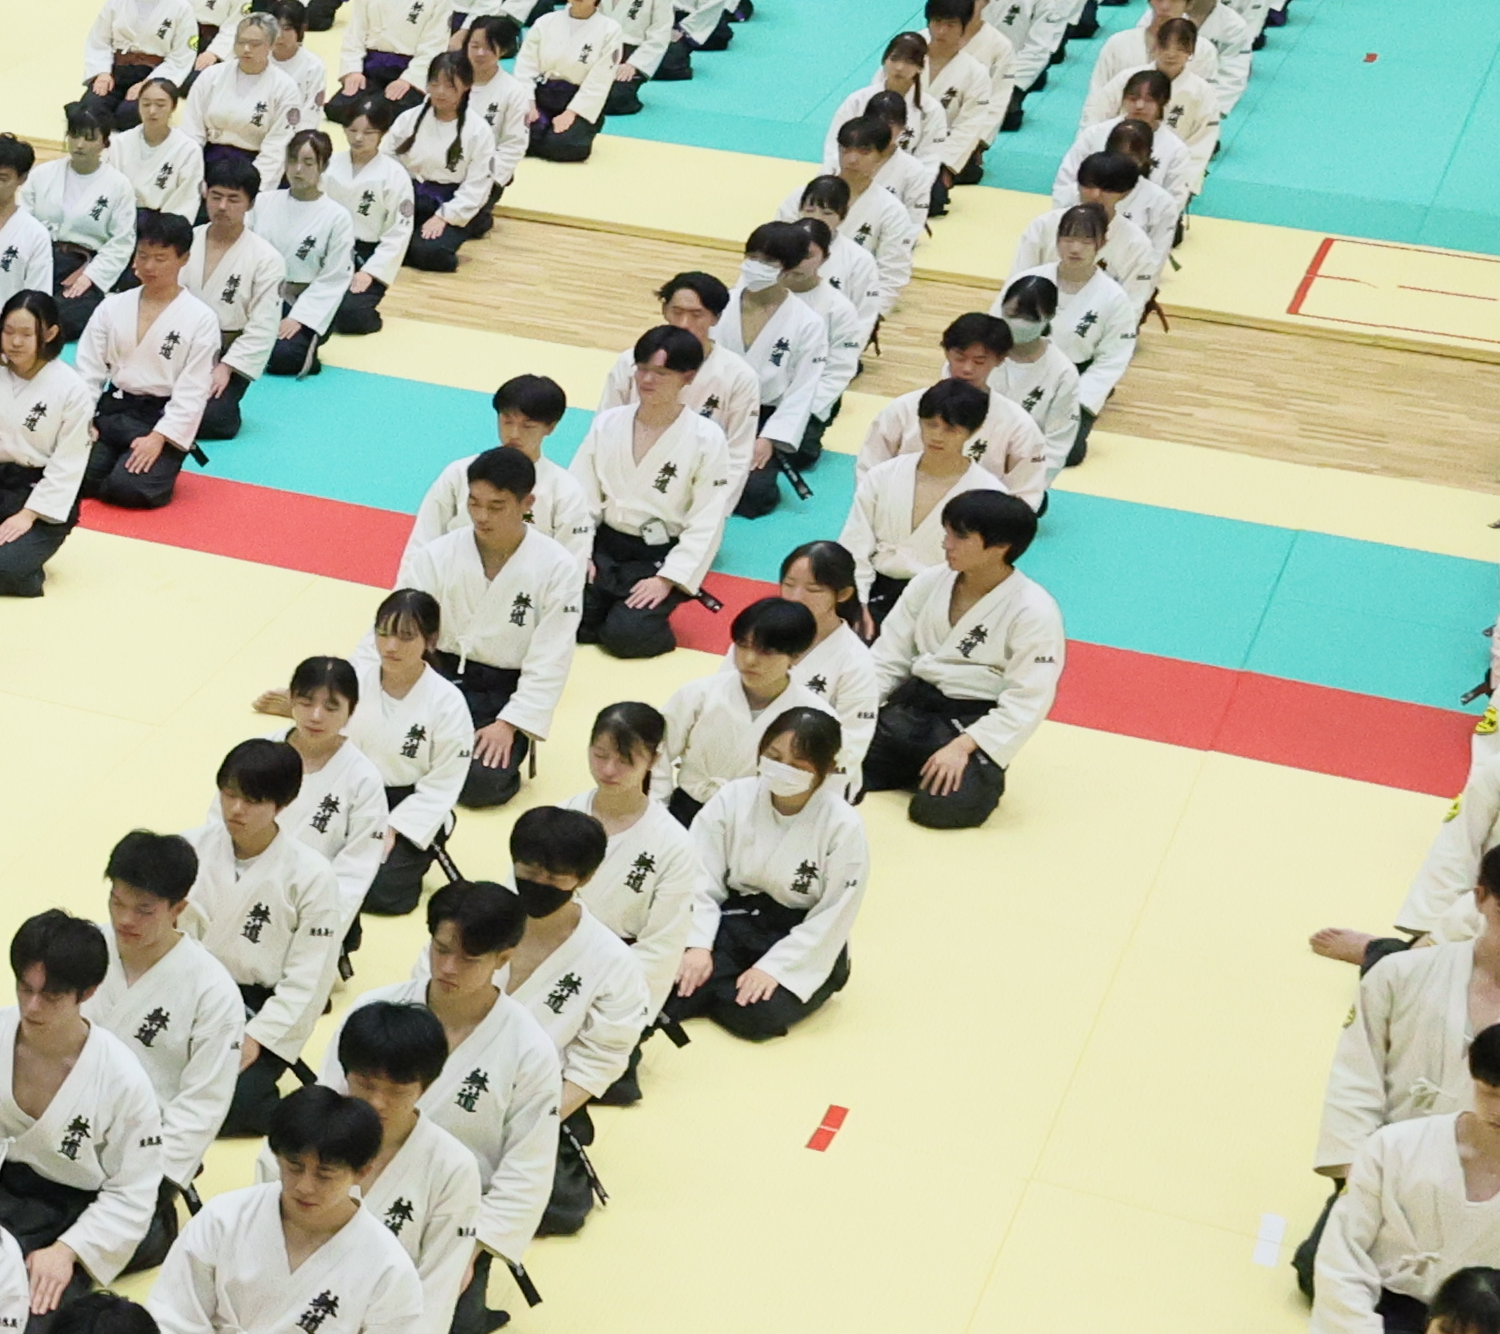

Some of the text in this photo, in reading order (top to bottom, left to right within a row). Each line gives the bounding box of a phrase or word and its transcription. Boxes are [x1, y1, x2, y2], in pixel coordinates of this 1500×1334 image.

[310, 794, 340, 834] 躰道
[624, 852, 655, 893] 躰道
[241, 903, 271, 944] 躰道
[544, 973, 581, 1014] 躰道
[134, 1007, 170, 1047] 躰道
[454, 1068, 489, 1112] 躰道
[58, 1115, 91, 1161] 躰道
